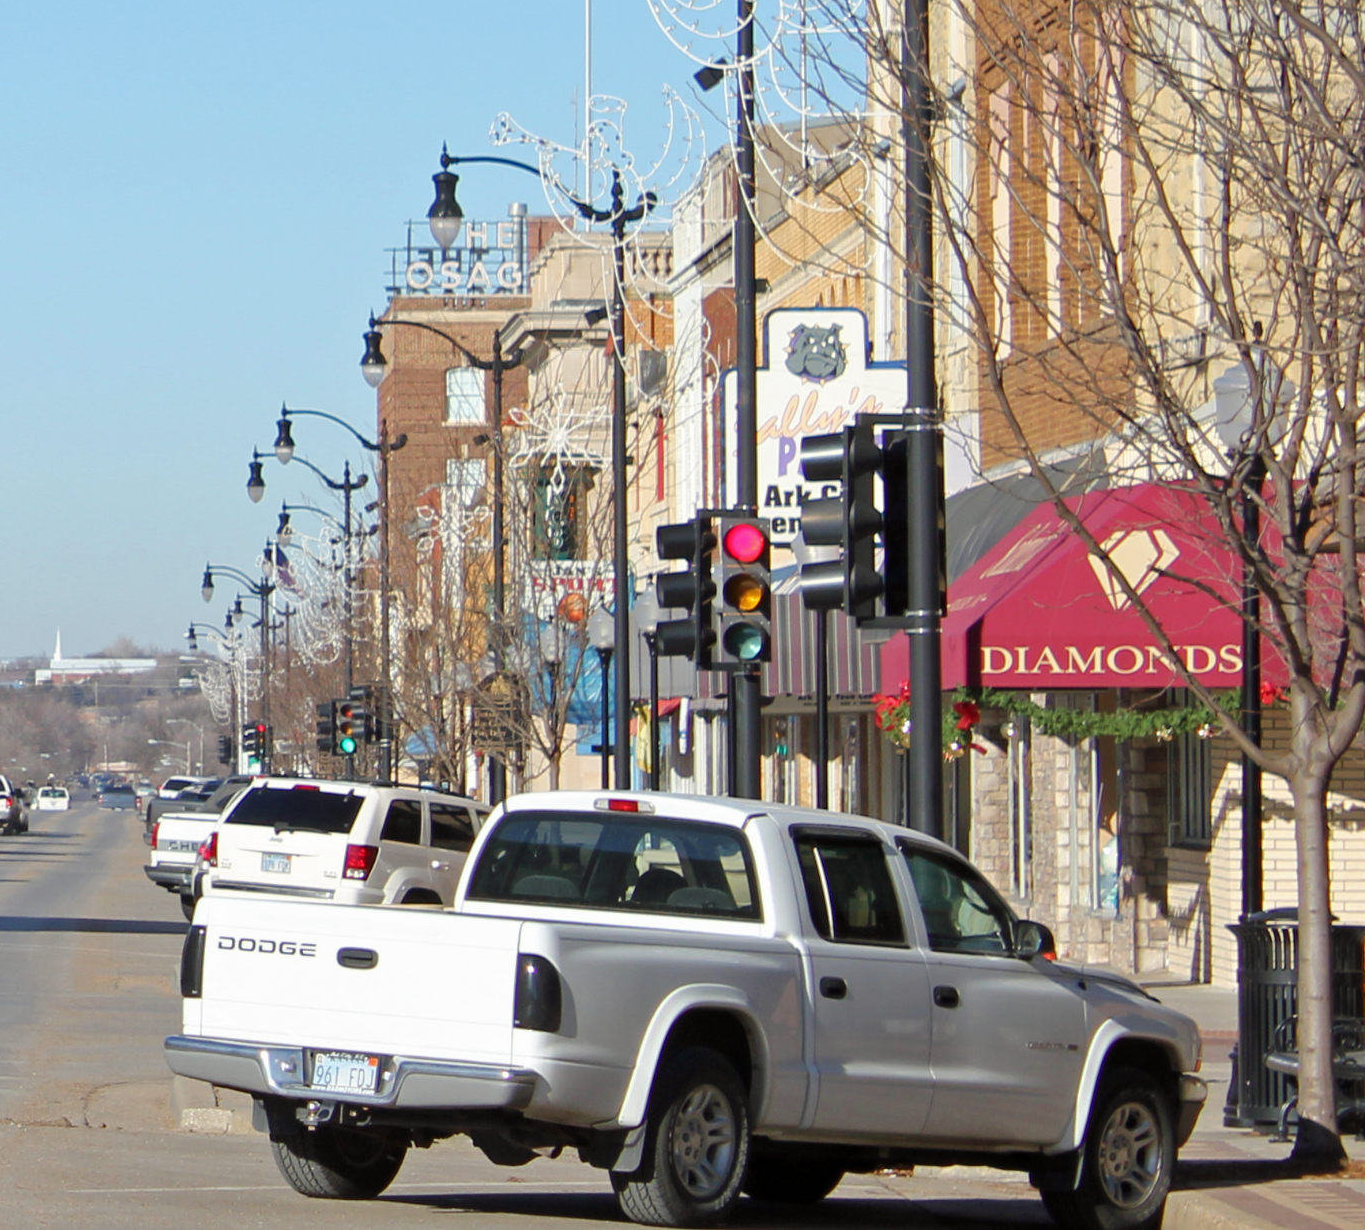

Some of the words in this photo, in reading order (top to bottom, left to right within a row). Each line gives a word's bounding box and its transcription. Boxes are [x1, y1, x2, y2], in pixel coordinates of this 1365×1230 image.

[466, 221, 514, 249] HE
[406, 260, 523, 289] OSAG
[755, 385, 884, 445] ally's
[764, 485, 812, 508] Ark
[980, 644, 1244, 674] DIAMONDS
[218, 935, 317, 957] DODGE
[316, 1064, 339, 1087] 961
[349, 1067, 374, 1088] FDJ
